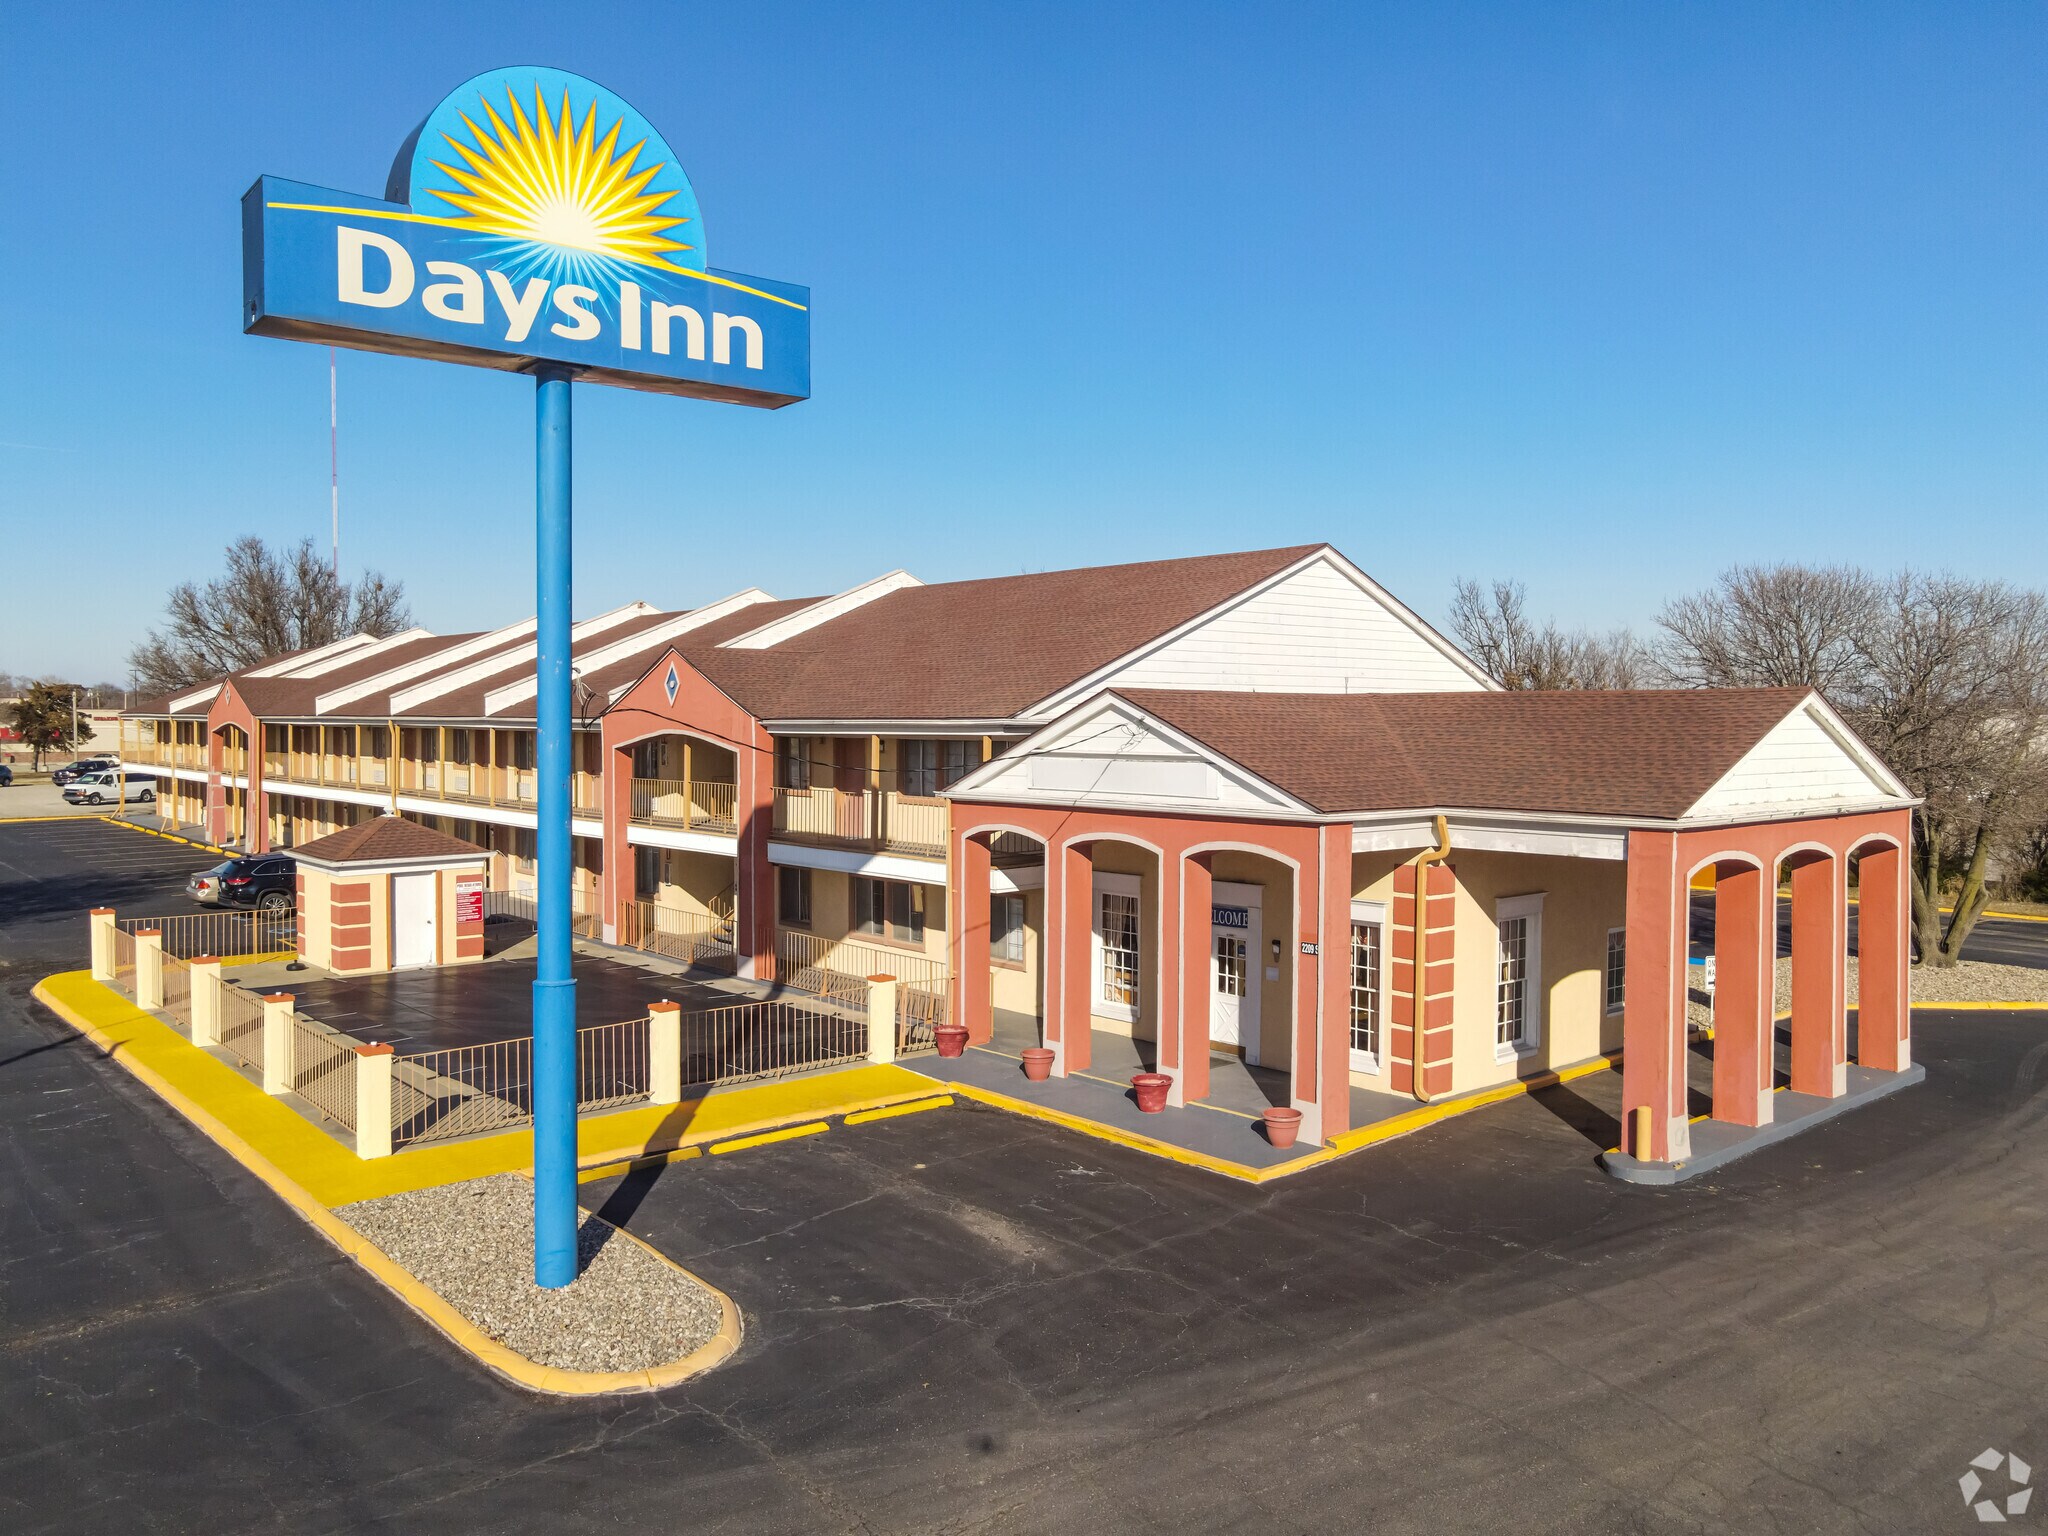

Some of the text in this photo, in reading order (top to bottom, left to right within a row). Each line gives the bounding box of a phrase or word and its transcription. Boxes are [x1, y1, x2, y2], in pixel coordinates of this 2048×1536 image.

[337, 226, 764, 371] Days Inn
[1212, 909, 1248, 926] LCOME
[1301, 943, 1315, 954] 2209
[1707, 960, 1716, 968] ON
[1707, 969, 1716, 977] WA
